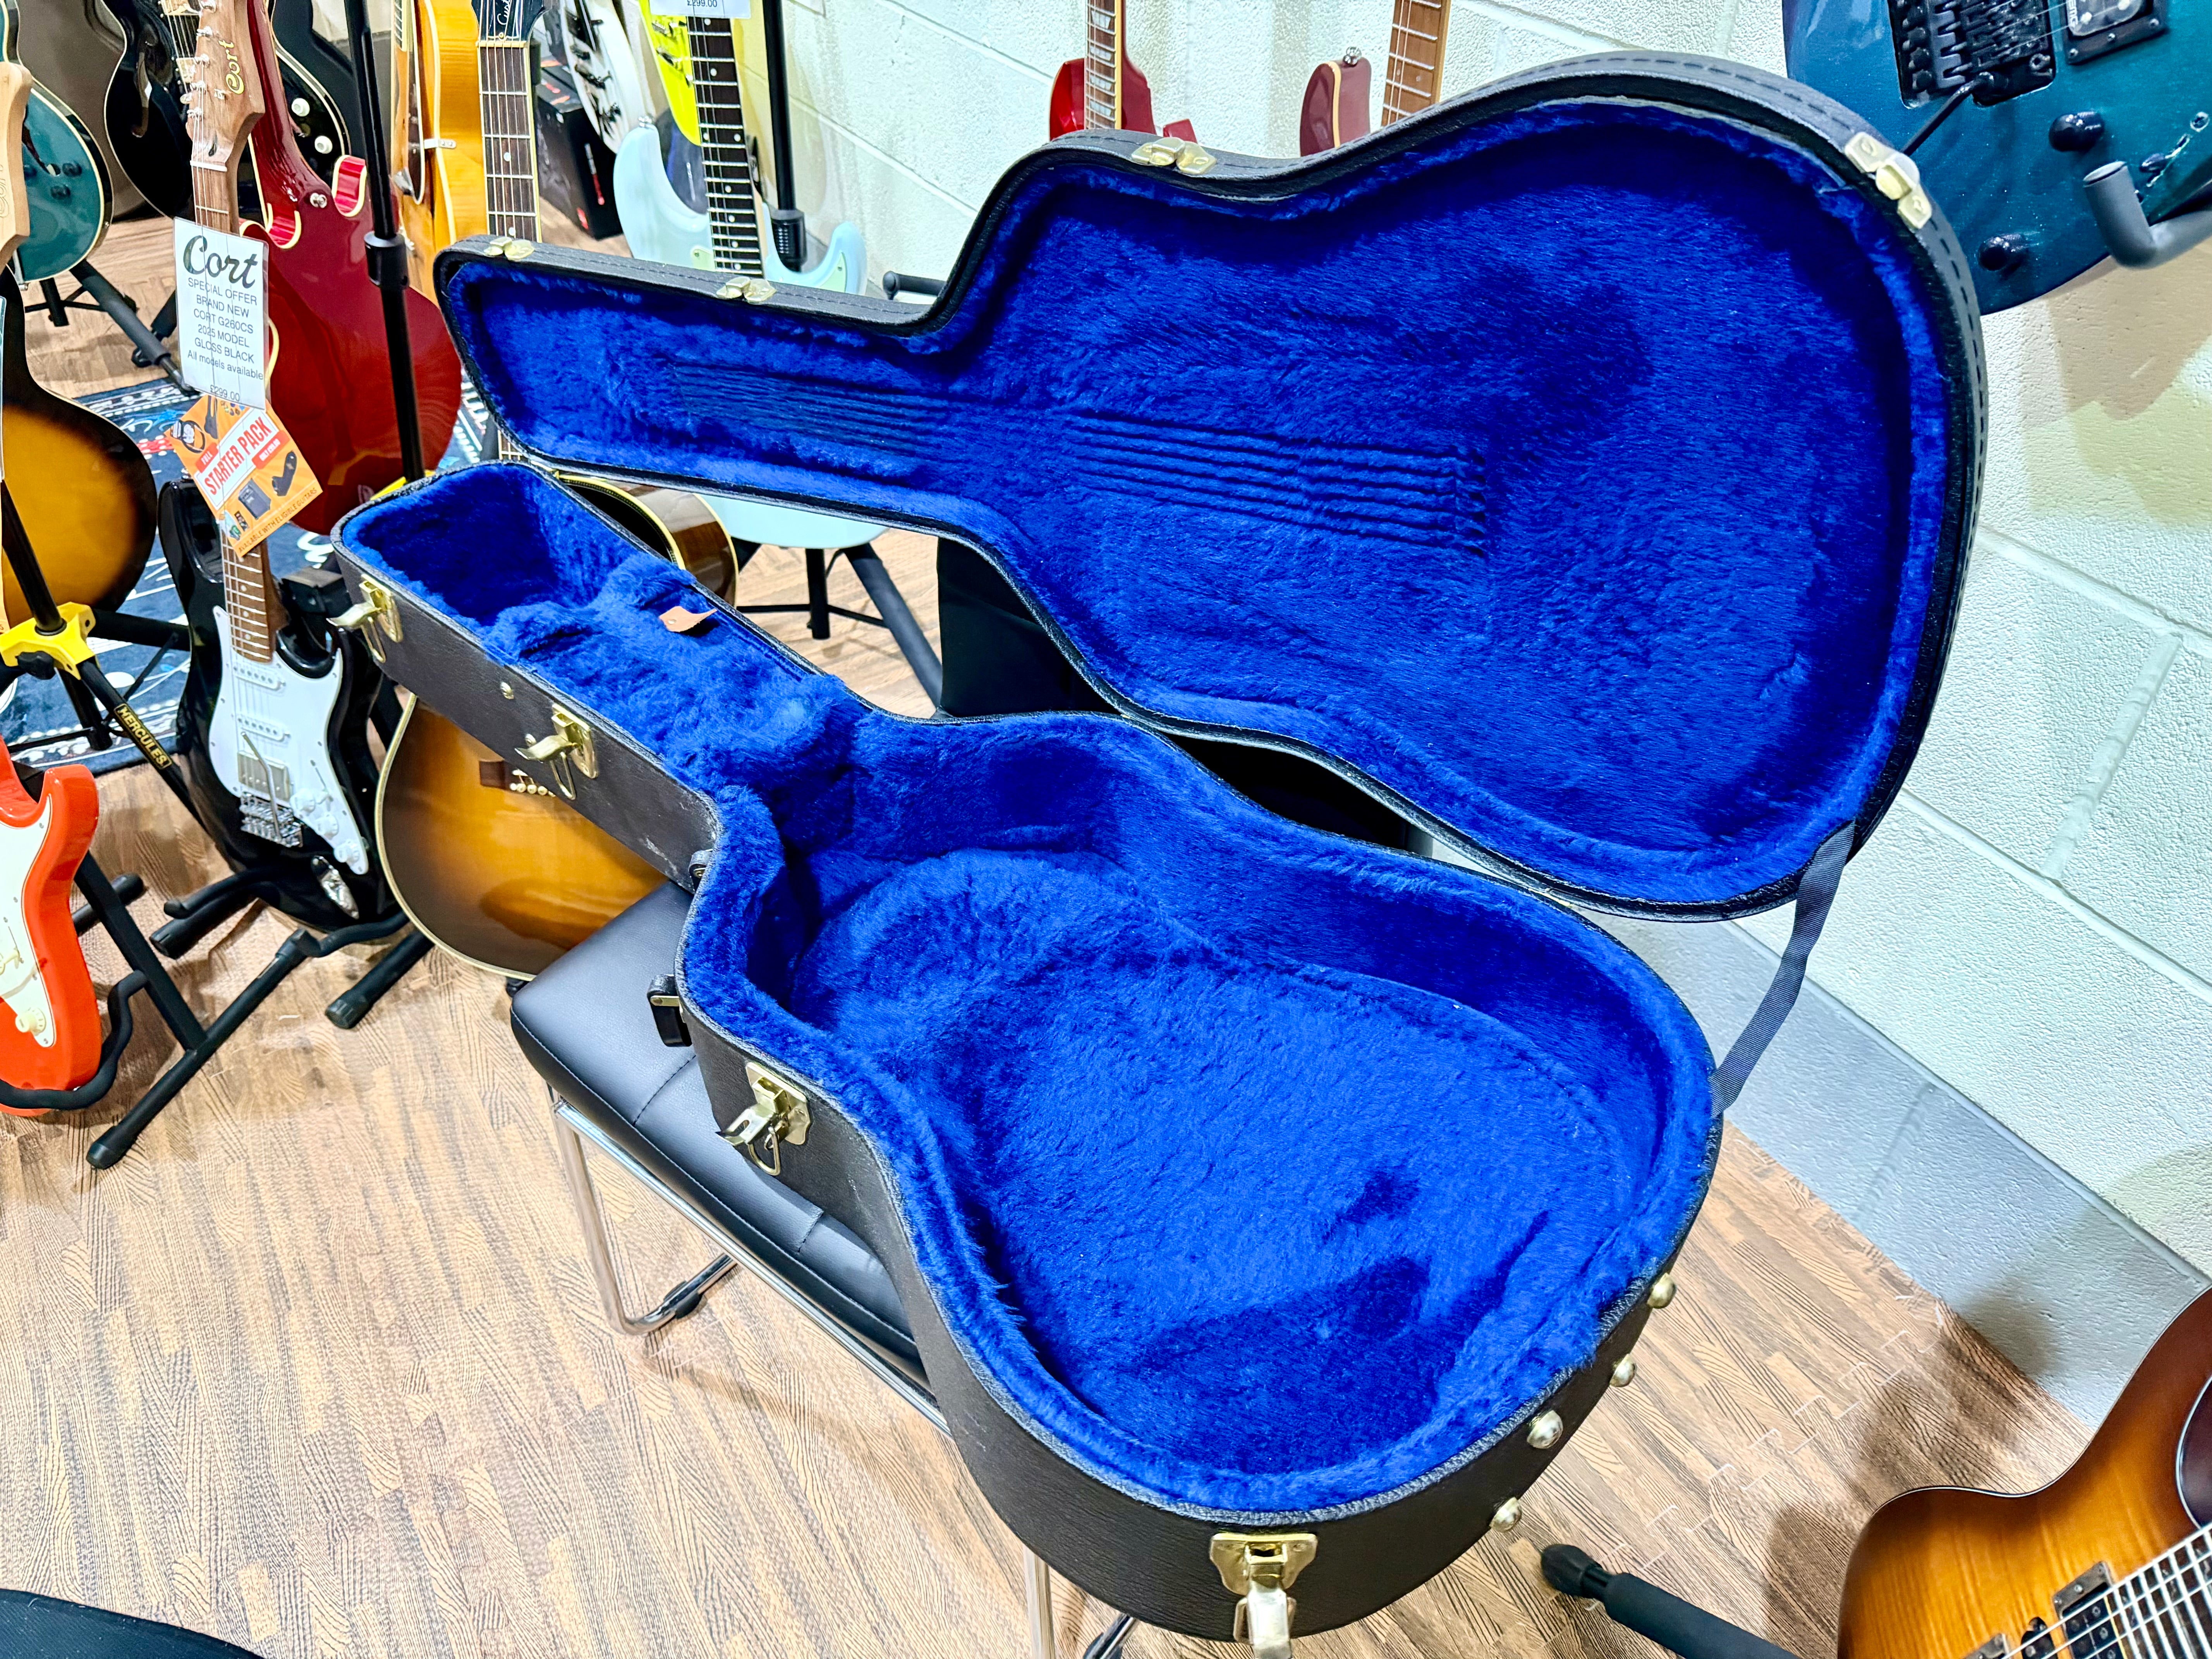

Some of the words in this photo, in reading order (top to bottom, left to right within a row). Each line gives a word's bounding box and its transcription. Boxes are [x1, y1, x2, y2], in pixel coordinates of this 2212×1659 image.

[218, 40, 245, 94] Cort
[183, 235, 258, 289] Cort
[188, 277, 223, 297] SPECIAL
[225, 289, 257, 306] OFFER
[196, 294, 224, 311] BRAND
[227, 304, 249, 318] NEW
[194, 309, 216, 323] CORT
[218, 316, 253, 333] G260CS
[198, 324, 215, 337] 2025
[218, 330, 250, 348] MODEL
[195, 337, 222, 354] GLOSS
[225, 347, 254, 364] BLACK
[187, 350, 197, 360] All
[199, 355, 225, 369] models
[227, 364, 263, 380] available
[210, 385, 240, 402] £299.00
[201, 451, 213, 465] FULL
[204, 445, 245, 495] STARTER
[237, 417, 272, 455] PACK
[239, 531, 263, 553] AVAILABLE
[262, 520, 276, 533] WITH
[275, 504, 297, 523] ELIGIBLE
[296, 488, 317, 507] GUITARS
